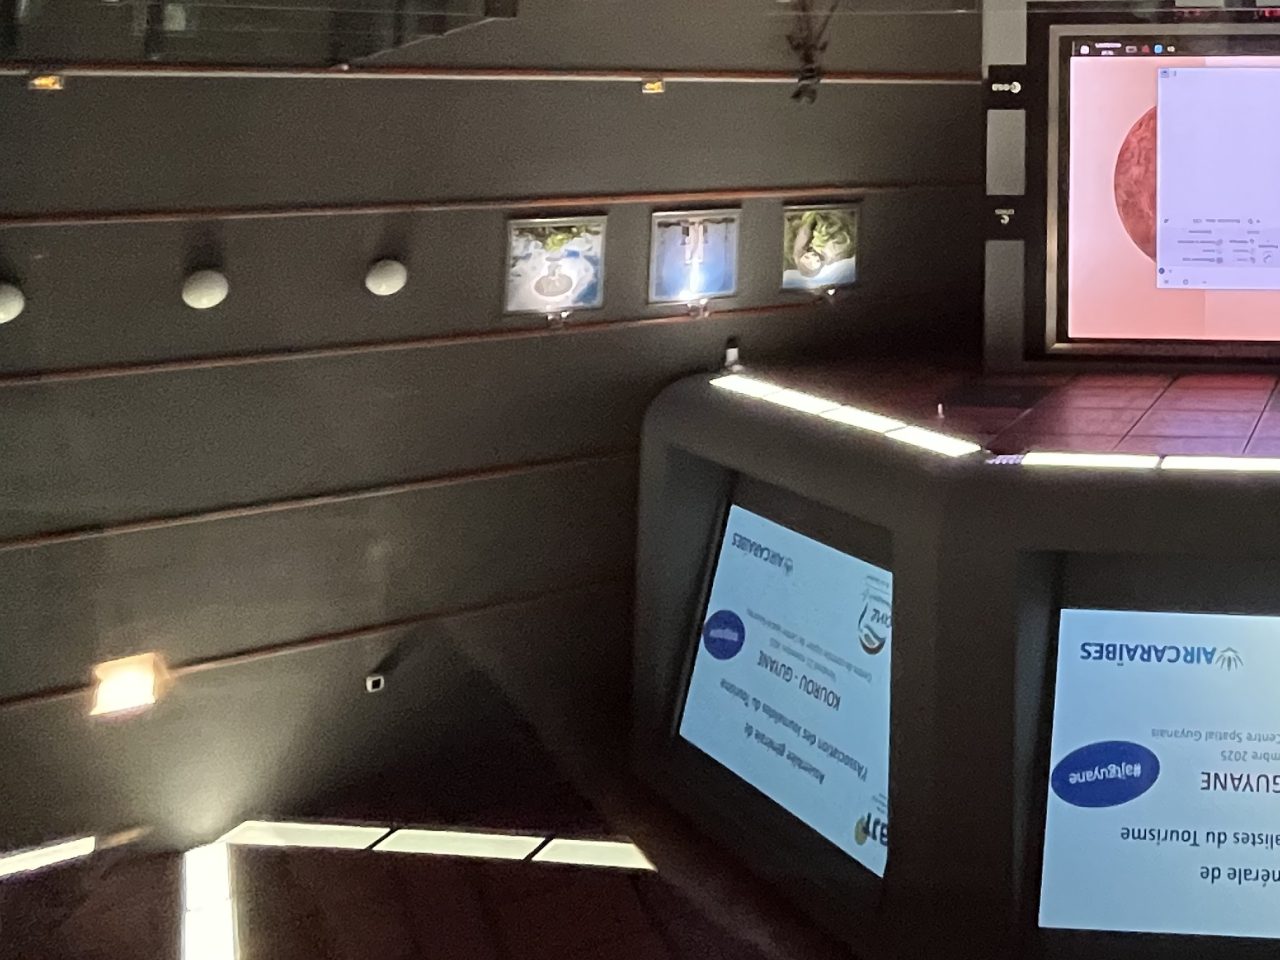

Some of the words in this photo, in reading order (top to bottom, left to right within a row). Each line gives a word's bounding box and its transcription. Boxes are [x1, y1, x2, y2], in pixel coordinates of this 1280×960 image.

[757, 650, 794, 683] GUYANE
[799, 674, 841, 711] KOUROU
[1151, 728, 1202, 741] Guyanais
[1205, 729, 1243, 743] Spatial
[1220, 750, 1248, 761] 2025
[1068, 762, 1142, 786] #ajtguyane
[1120, 827, 1200, 847] Tourisme
[1206, 831, 1227, 849] du
[1199, 866, 1221, 885] de
